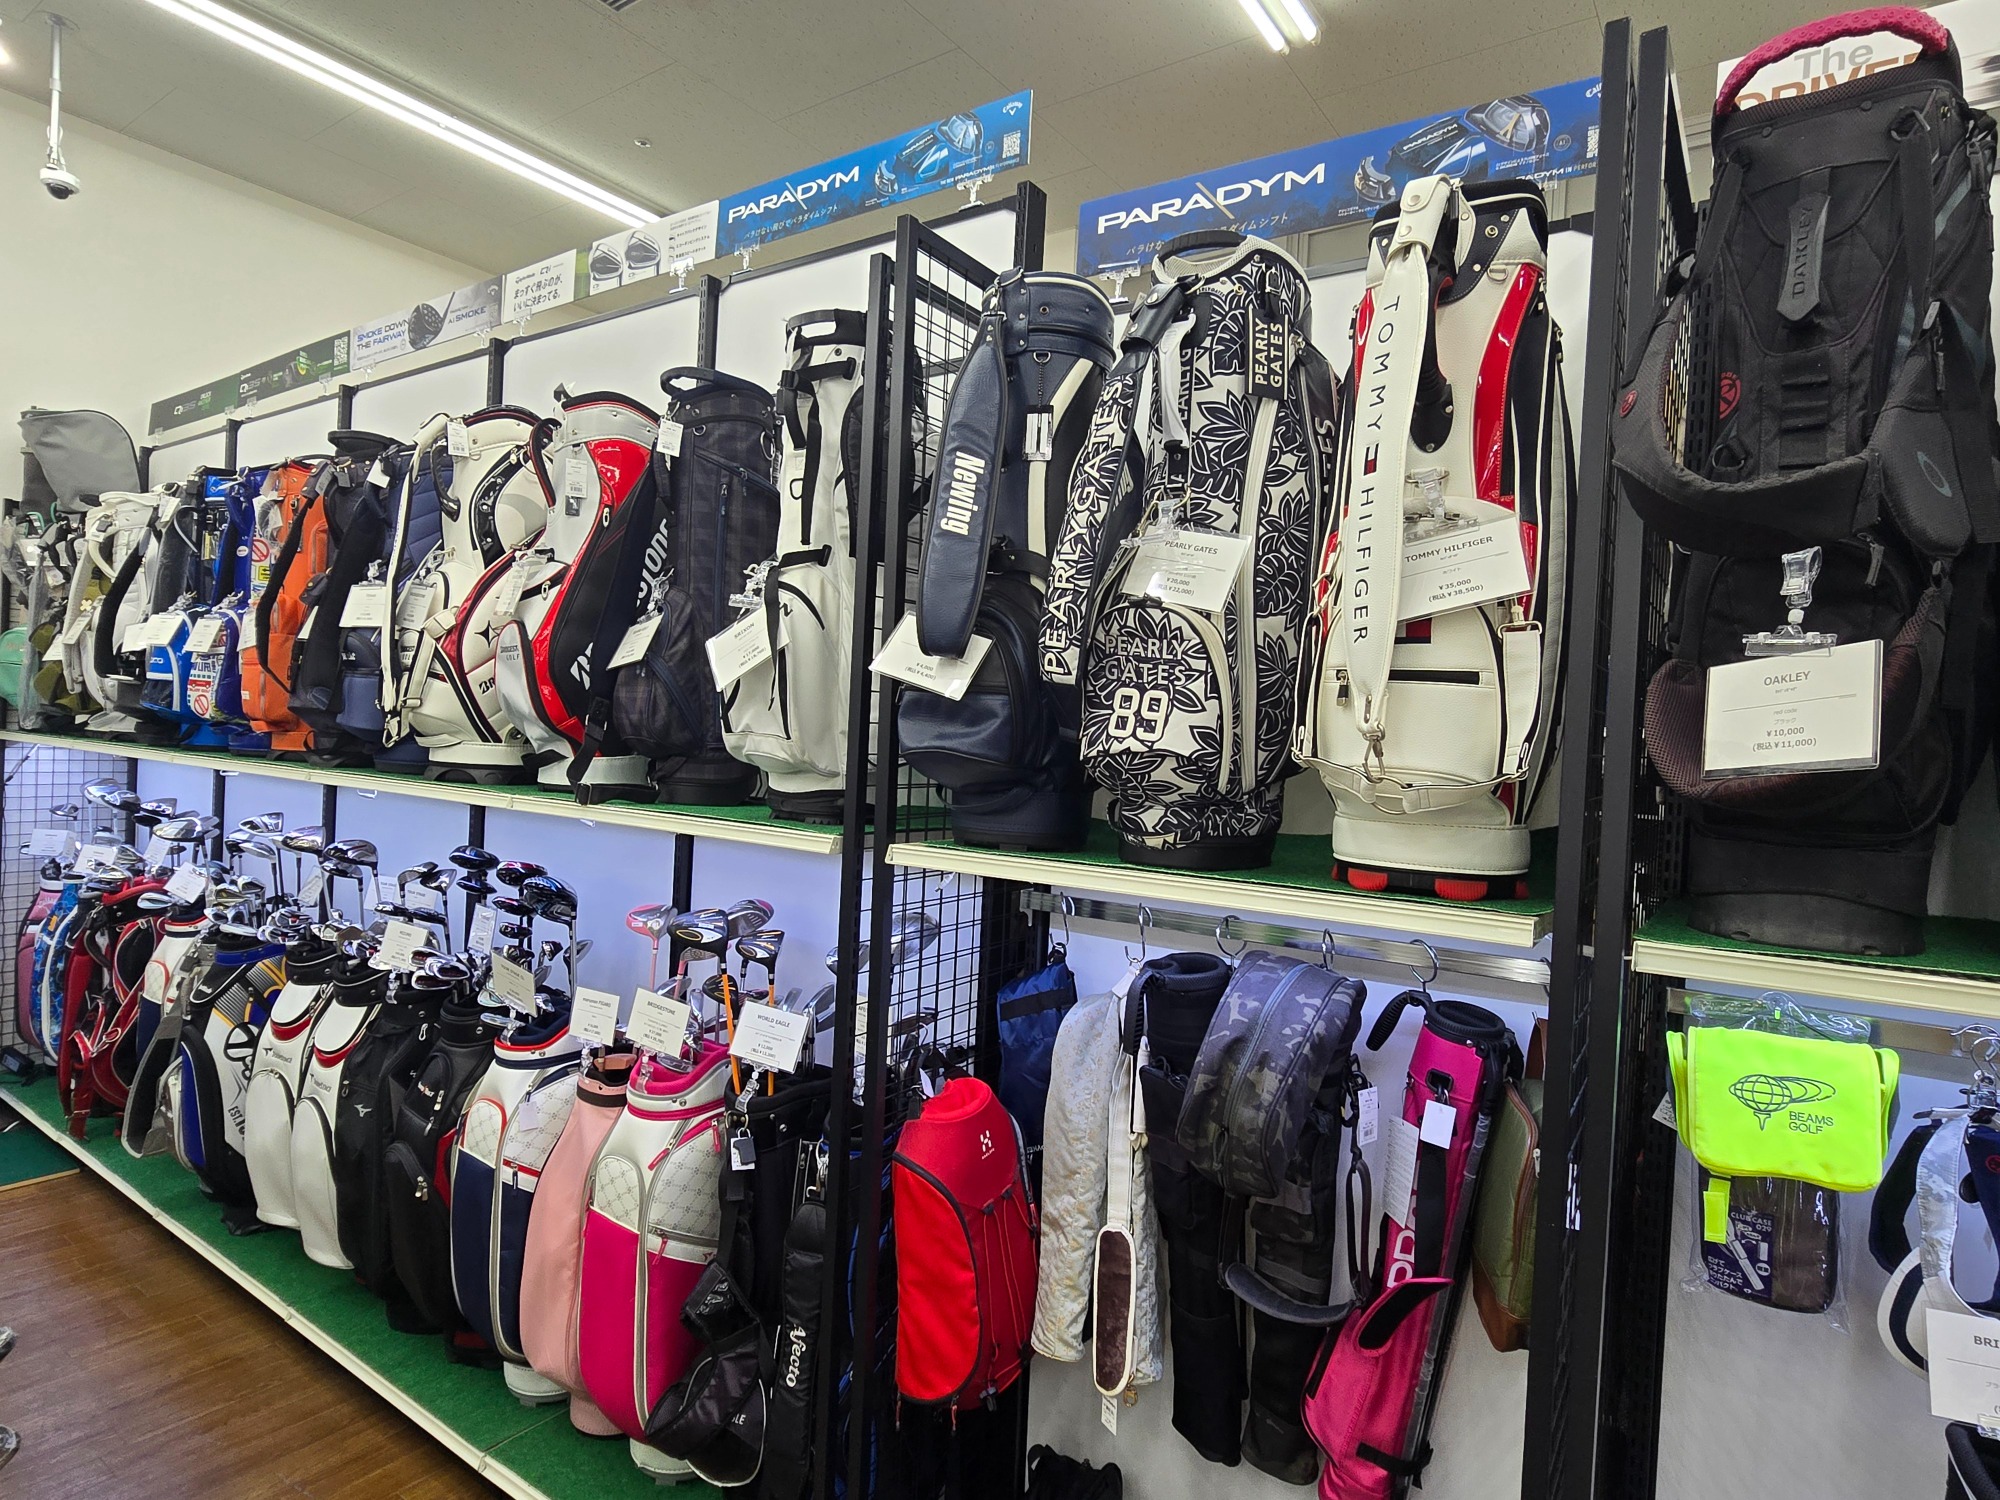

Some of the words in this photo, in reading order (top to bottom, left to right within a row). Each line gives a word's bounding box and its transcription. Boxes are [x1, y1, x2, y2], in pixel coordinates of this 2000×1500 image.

[1794, 44, 1874, 80] The
[1403, 123, 1458, 150] PARADYM
[728, 166, 859, 223] PARADYM
[1097, 163, 1325, 234] PARADYM
[1792, 207, 1813, 299] OAKLEY
[455, 306, 487, 322] SMOKE
[357, 327, 383, 342] SMOKE
[357, 341, 371, 351] THE
[372, 329, 407, 345] FAIRWAY
[1254, 318, 1269, 385] PEARLY
[1269, 322, 1283, 388] GATES
[1367, 296, 1400, 431] TOMMY
[940, 451, 985, 536] Newing
[1164, 540, 1193, 551] PEARLY
[1193, 544, 1218, 555] GATES
[1405, 548, 1441, 563] TOMMY
[1444, 536, 1494, 553] HILFIGER
[1353, 486, 1375, 644] HILFIGER
[1106, 635, 1192, 660] PEARLY
[1106, 664, 1187, 686] GATES
[1763, 670, 1812, 687] OAKLEY
[1108, 687, 1169, 742] 89
[647, 1001, 676, 1016] BRIDGESTONE
[757, 1014, 774, 1024] WORLD
[775, 1018, 790, 1028] EAGLE
[1789, 1110, 1834, 1127] BEAMS
[1789, 1121, 1823, 1135] GOLF
[1730, 1211, 1752, 1222] CLUB
[1752, 1216, 1773, 1227] CASE
[1755, 1222, 1773, 1232] 029
